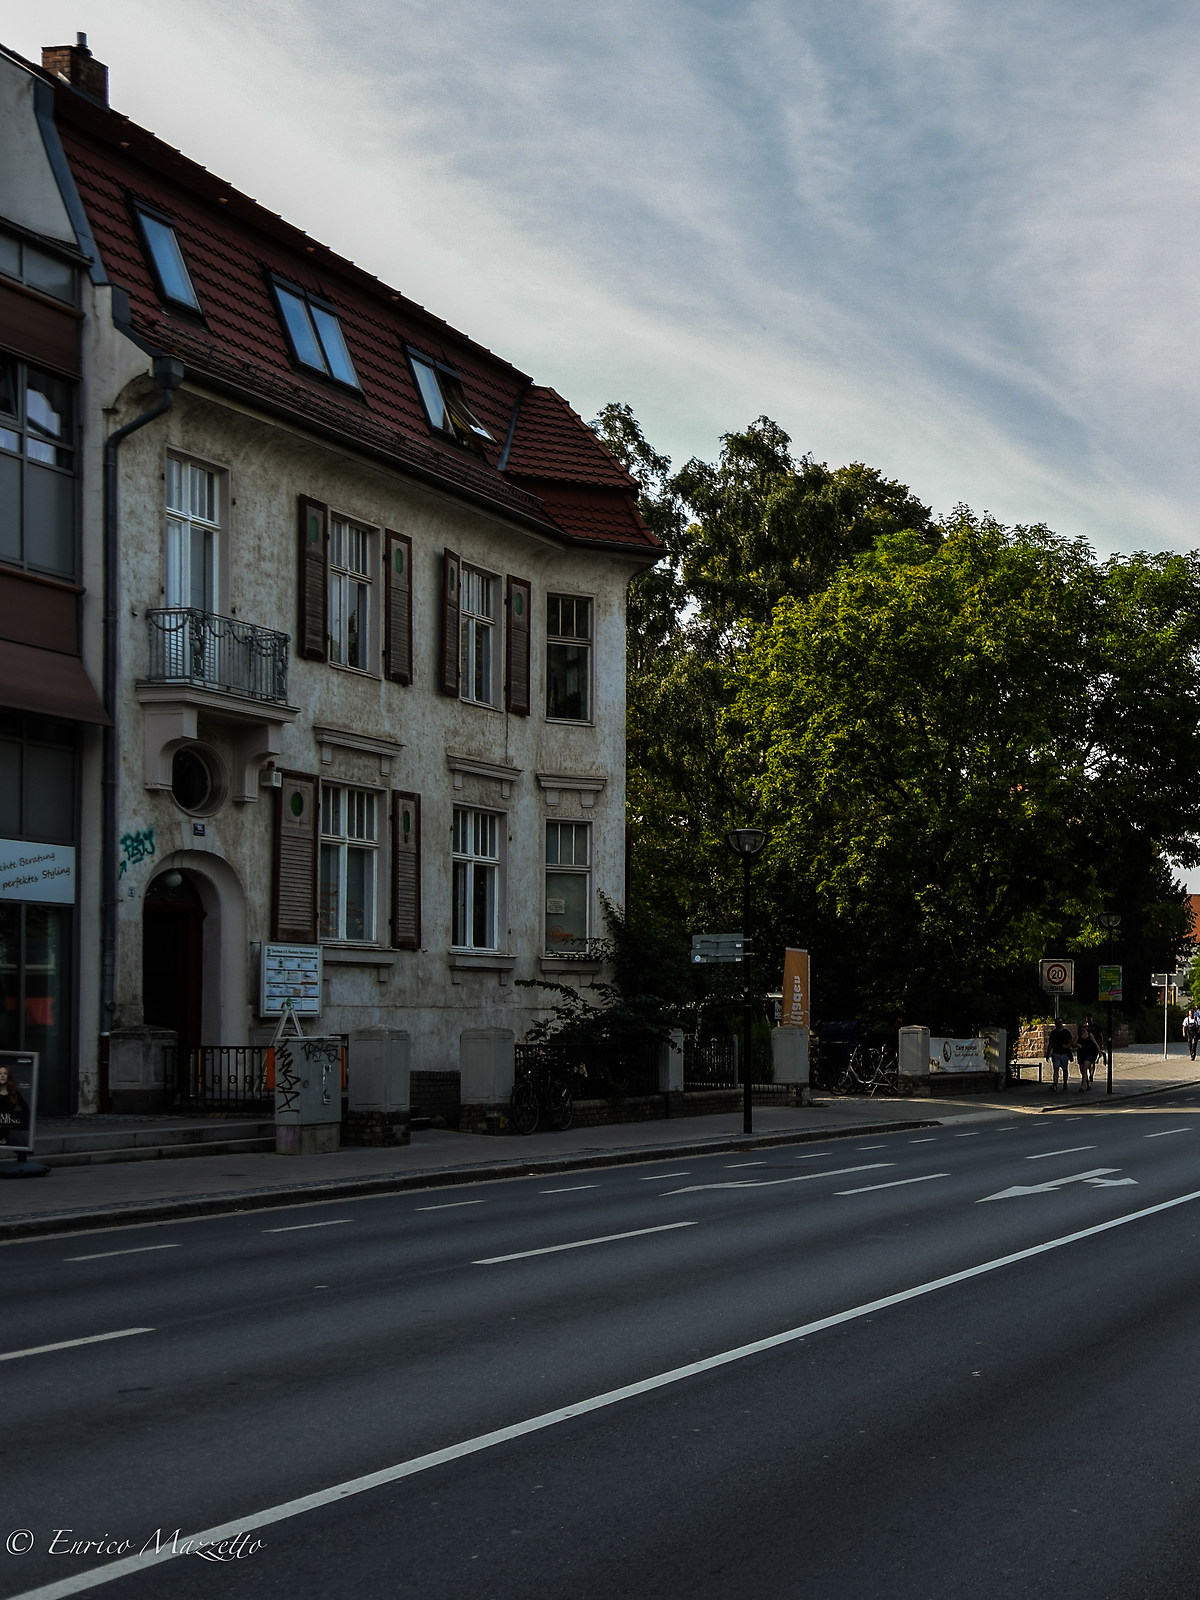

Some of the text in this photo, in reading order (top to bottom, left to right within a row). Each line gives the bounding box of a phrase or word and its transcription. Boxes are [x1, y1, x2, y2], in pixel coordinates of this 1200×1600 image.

[19, 852, 55, 867] Beratung
[3, 866, 71, 891] perfektes Styling
[1051, 969, 1063, 979] 20
